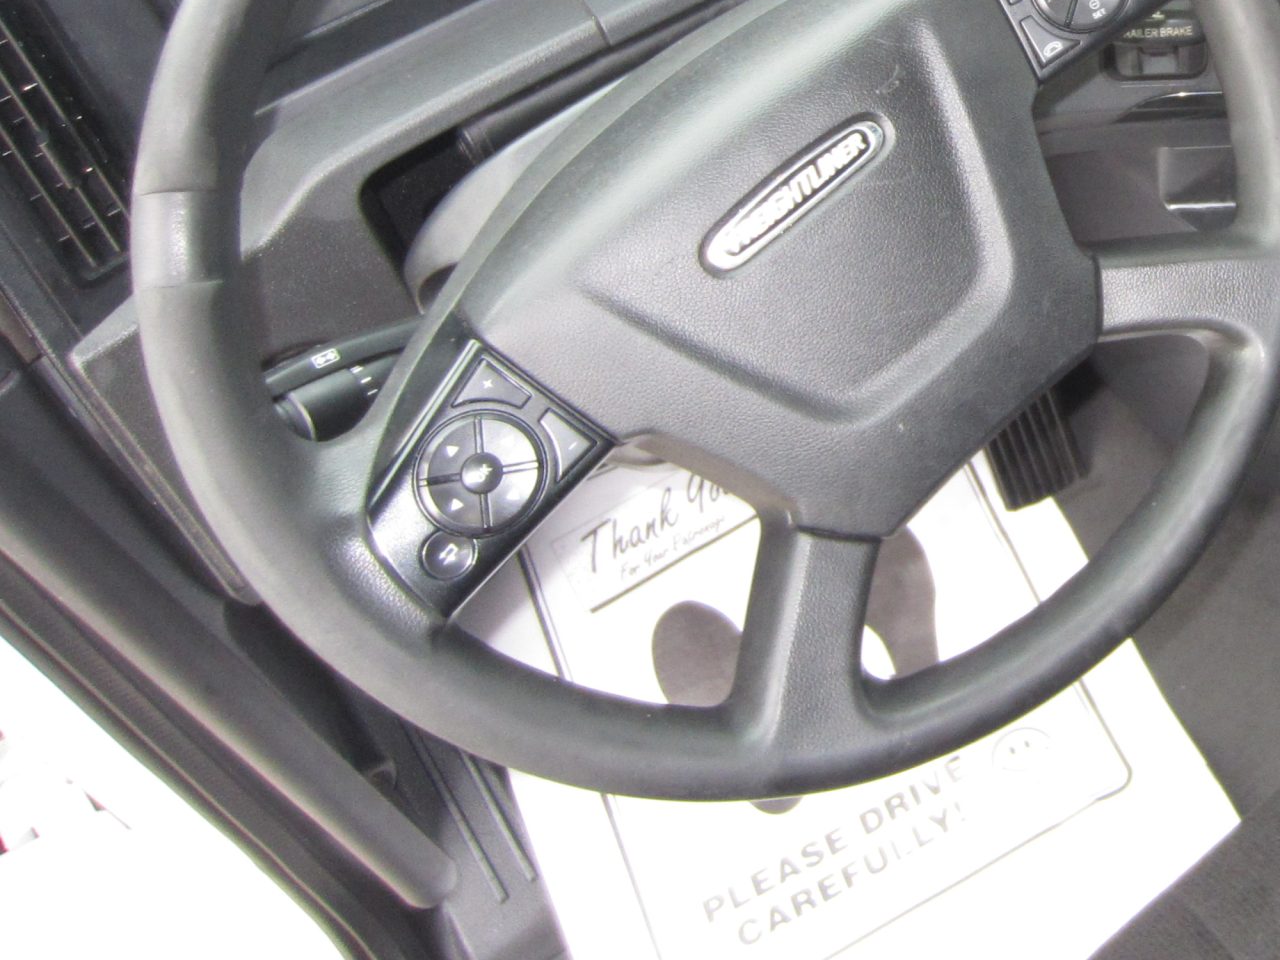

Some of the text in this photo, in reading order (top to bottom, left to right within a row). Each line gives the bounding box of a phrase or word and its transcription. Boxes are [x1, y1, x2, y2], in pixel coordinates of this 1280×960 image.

[1092, 8, 1107, 19] SET
[1122, 25, 1193, 39] RAILER BRAKE
[580, 472, 730, 573] Thank Yo
[702, 755, 963, 923] PLEASE DRIVE
[738, 801, 967, 945] CAREFULLY!
